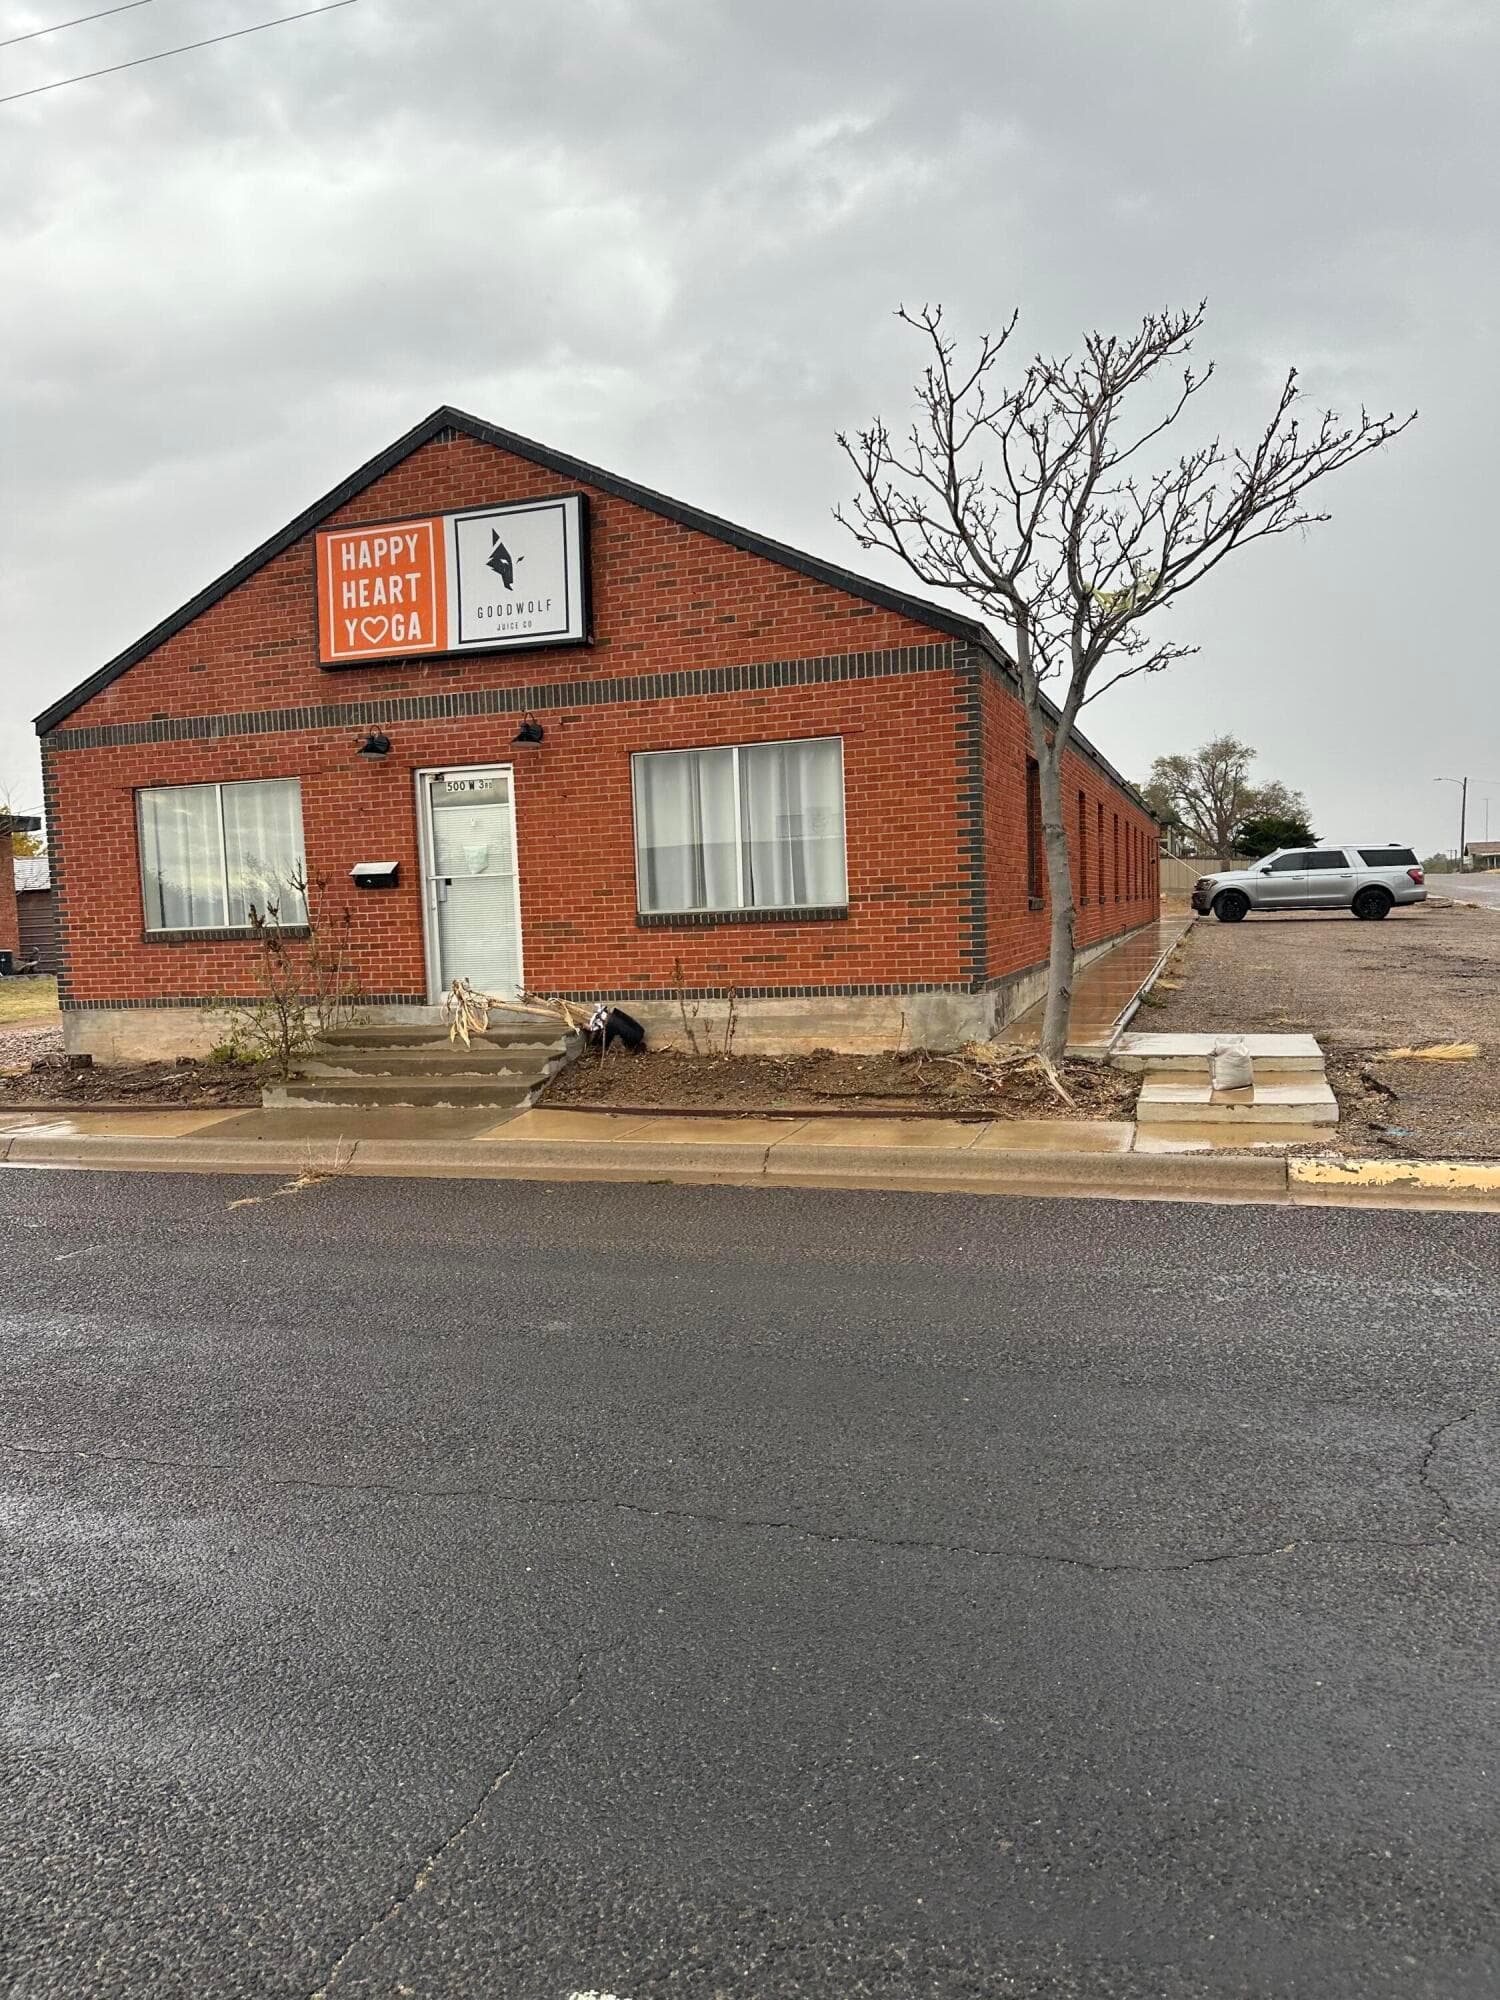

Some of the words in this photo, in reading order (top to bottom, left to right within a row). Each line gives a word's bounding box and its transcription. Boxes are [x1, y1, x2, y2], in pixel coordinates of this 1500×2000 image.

[341, 533, 418, 571] HAPPY
[343, 572, 421, 609] HEART
[477, 599, 552, 619] GOODWOLF
[496, 621, 519, 631] JUICE
[522, 621, 533, 629] CO
[447, 781, 465, 791] 500
[469, 780, 475, 790] W
